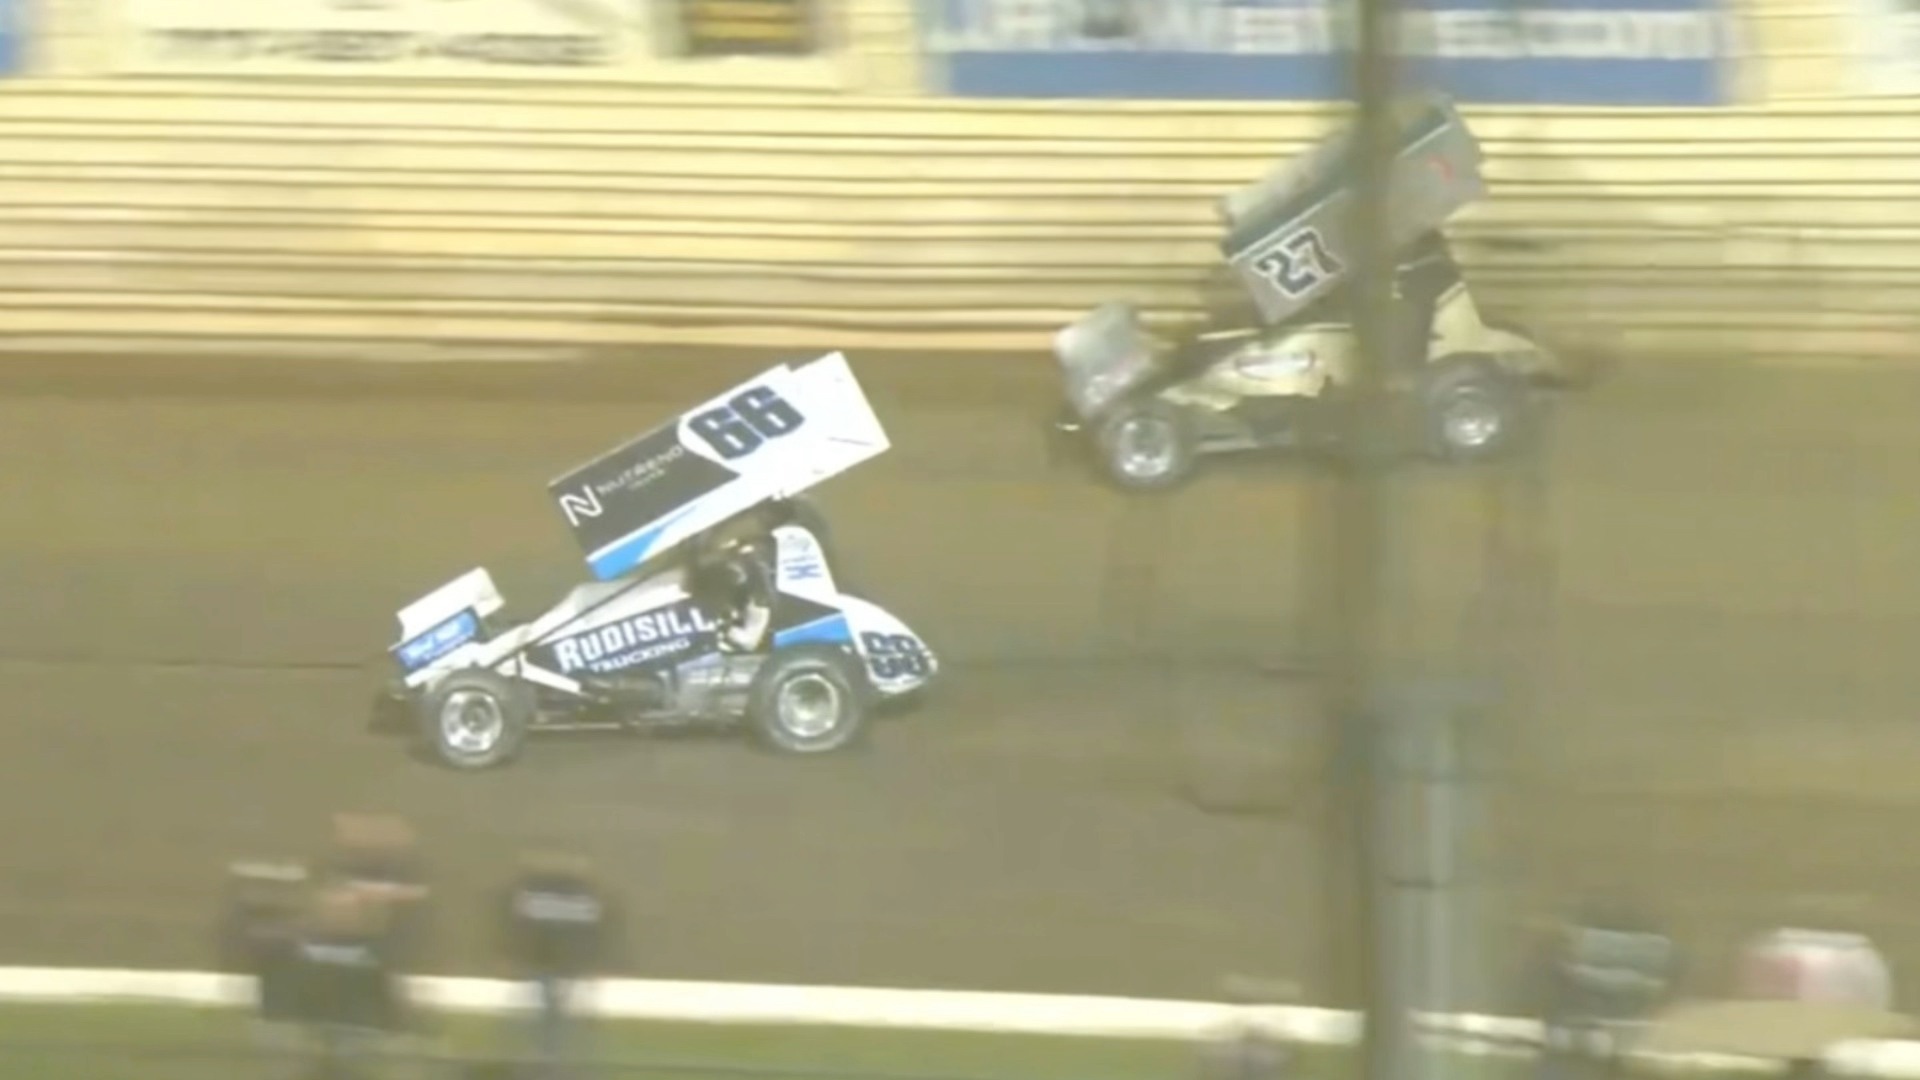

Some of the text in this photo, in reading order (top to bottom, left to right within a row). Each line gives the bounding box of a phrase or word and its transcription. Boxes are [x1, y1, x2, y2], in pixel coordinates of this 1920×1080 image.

[1252, 226, 1344, 299] 27
[687, 385, 805, 461] 66
[559, 484, 603, 527] N
[554, 607, 716, 674] RUDISILL
[589, 638, 691, 672] TRUCKING
